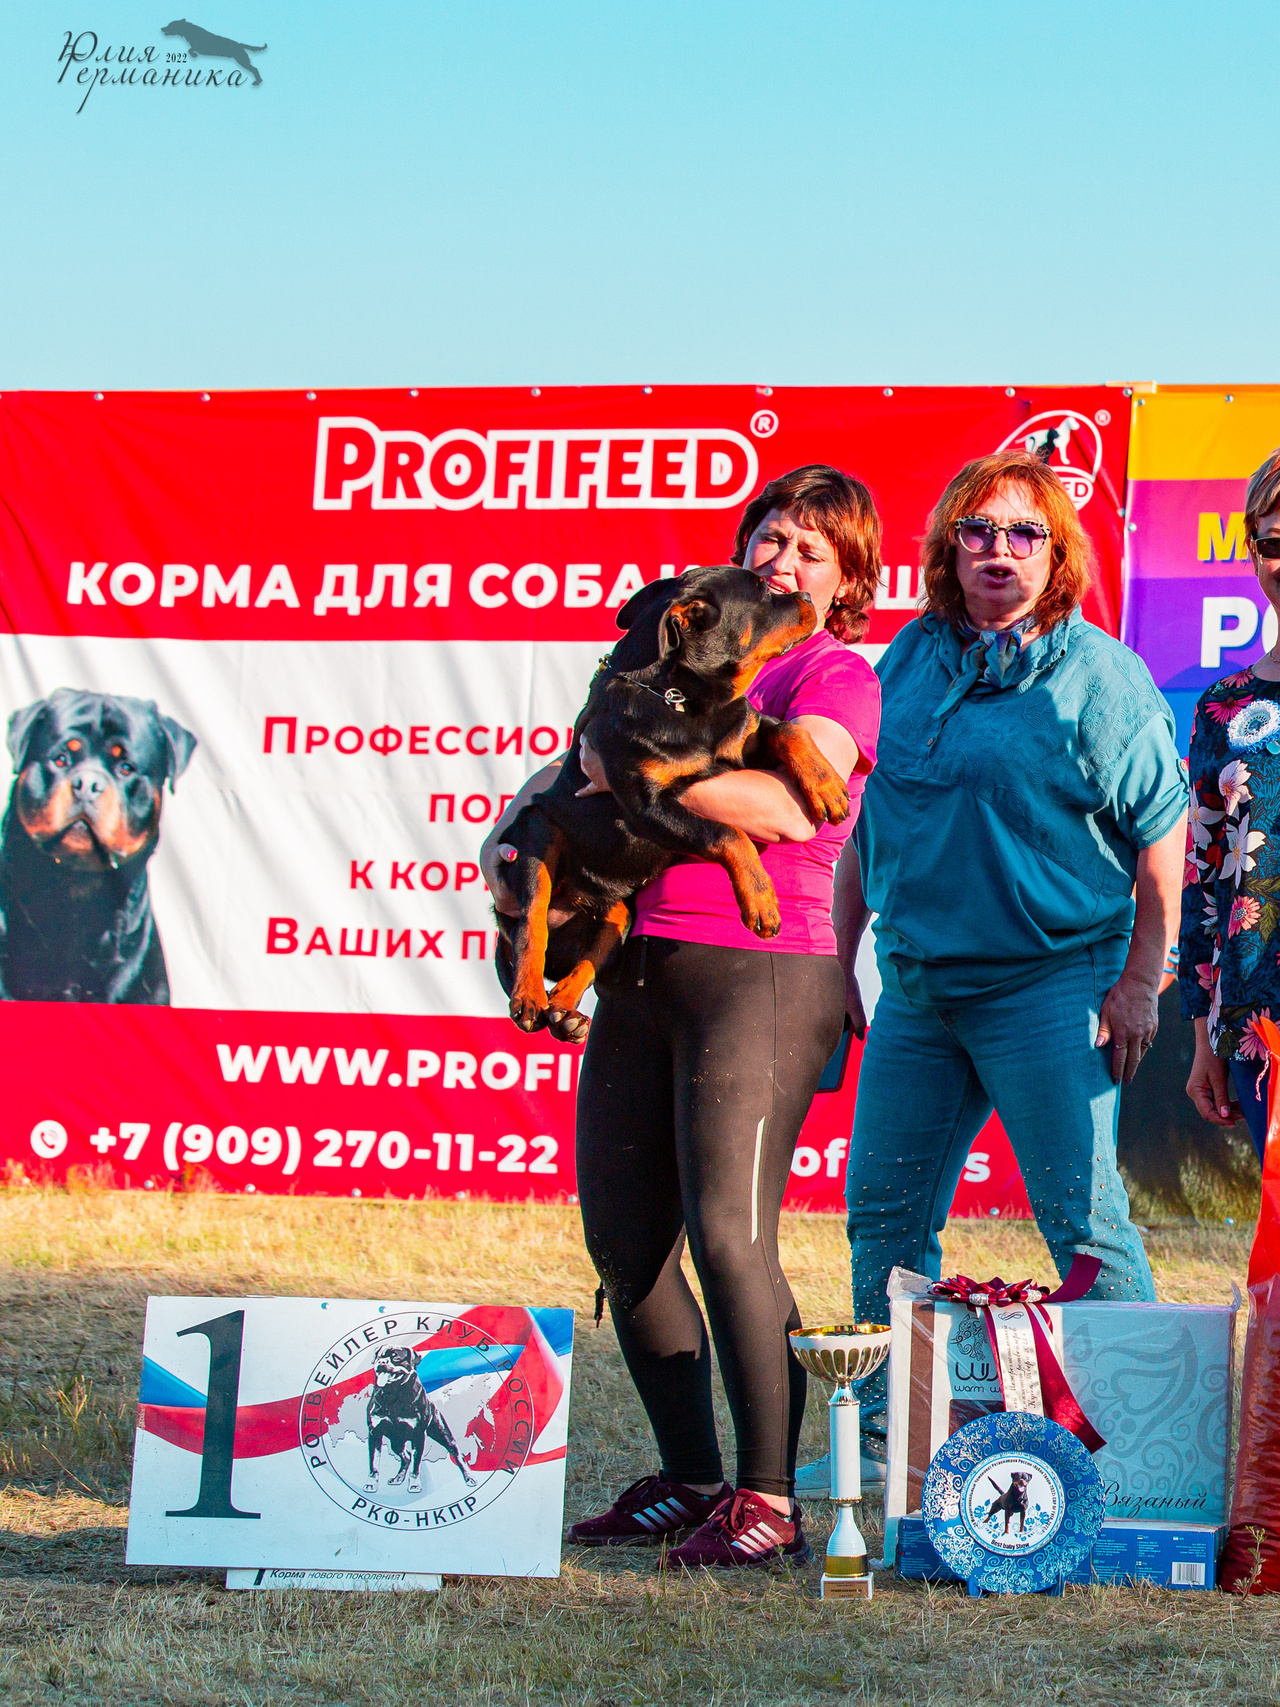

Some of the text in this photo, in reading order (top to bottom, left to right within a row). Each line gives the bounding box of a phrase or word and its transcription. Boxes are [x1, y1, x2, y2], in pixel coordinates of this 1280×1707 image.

[67, 562, 299, 609] КОРМА
[314, 563, 452, 616] ДЛЯ
[267, 917, 445, 960] ВАШИХ
[90, 1123, 559, 1175] +7 (909) 270-11-22
[303, 1315, 531, 1477] РОТВЕЙЛЕР КЛУБ РОССИИ
[954, 1385, 985, 1393] warm
[165, 1309, 261, 1519] 1
[350, 1495, 479, 1528] РКФ-НКПР
[1103, 1479, 1208, 1519] Вязаный
[270, 1569, 400, 1582] Корма нового поколения
